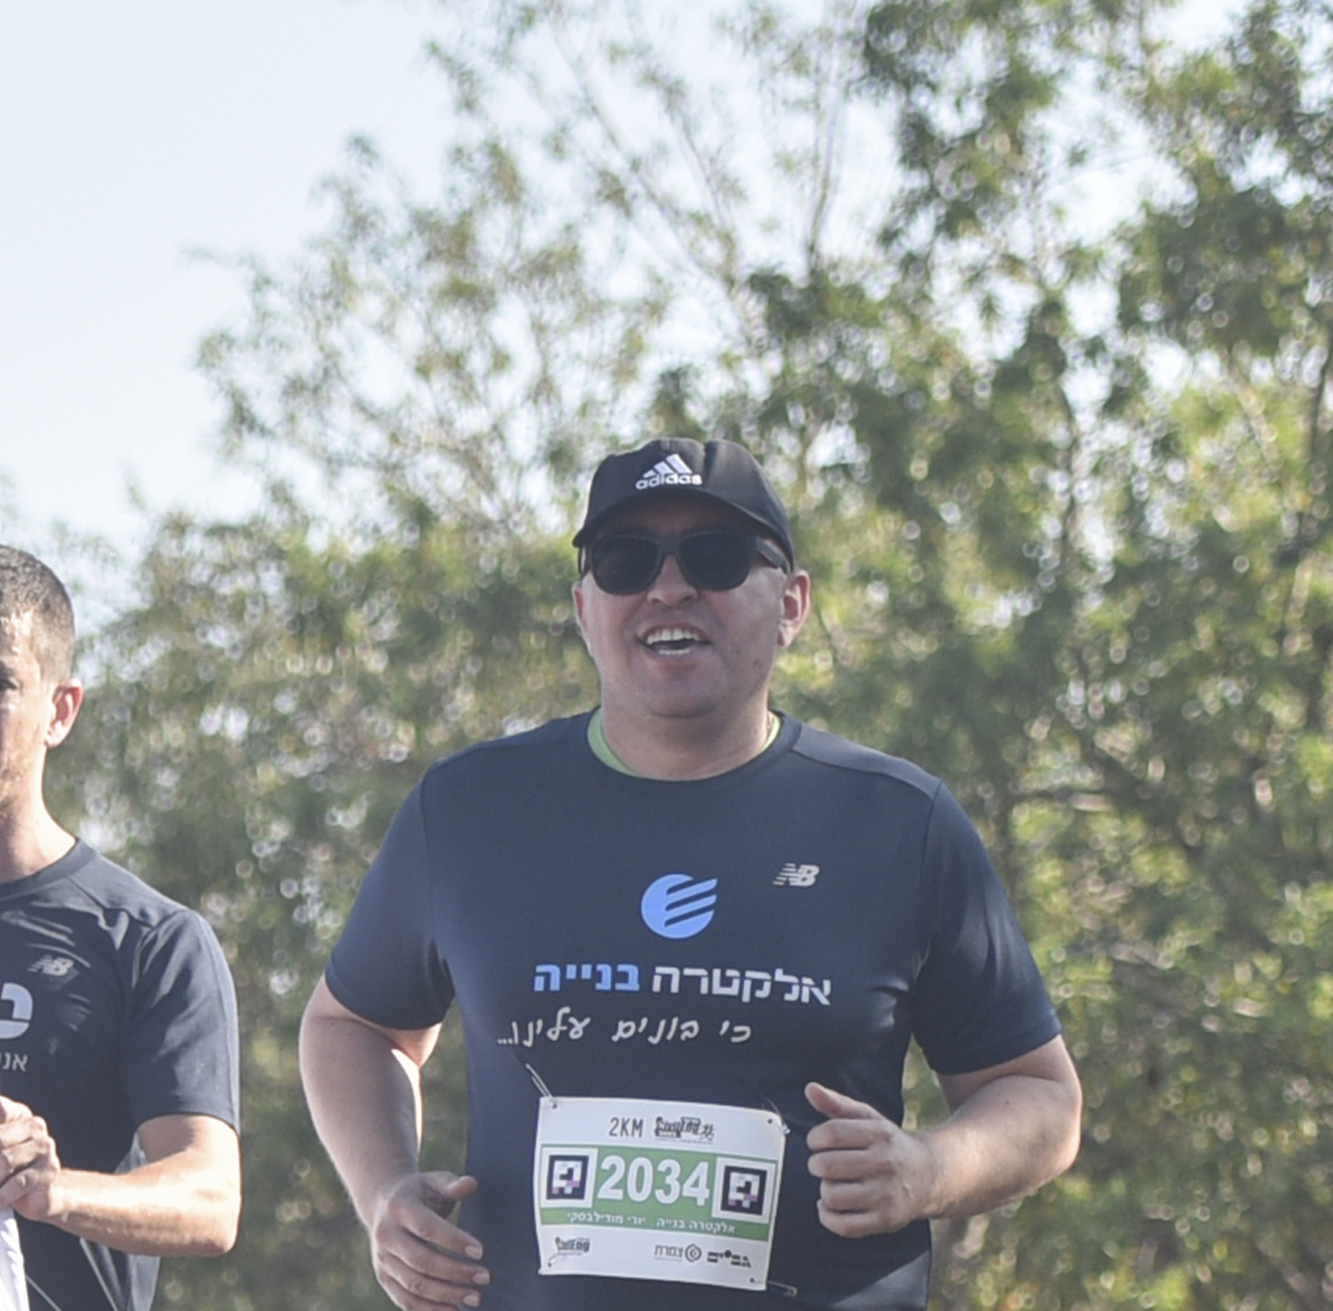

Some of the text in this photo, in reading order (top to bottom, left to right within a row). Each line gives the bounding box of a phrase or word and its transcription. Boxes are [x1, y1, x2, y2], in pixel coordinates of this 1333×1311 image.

[635, 473, 703, 491] adidas
[533, 962, 832, 1006] אלקטרה בנייה
[612, 1016, 700, 1046] בונים
[719, 1019, 752, 1044] כי
[608, 1117, 643, 1138] 2KM
[597, 1154, 711, 1207] 2034
[656, 1217, 686, 1229] בנייה
[689, 1219, 736, 1234] אלקטרה
